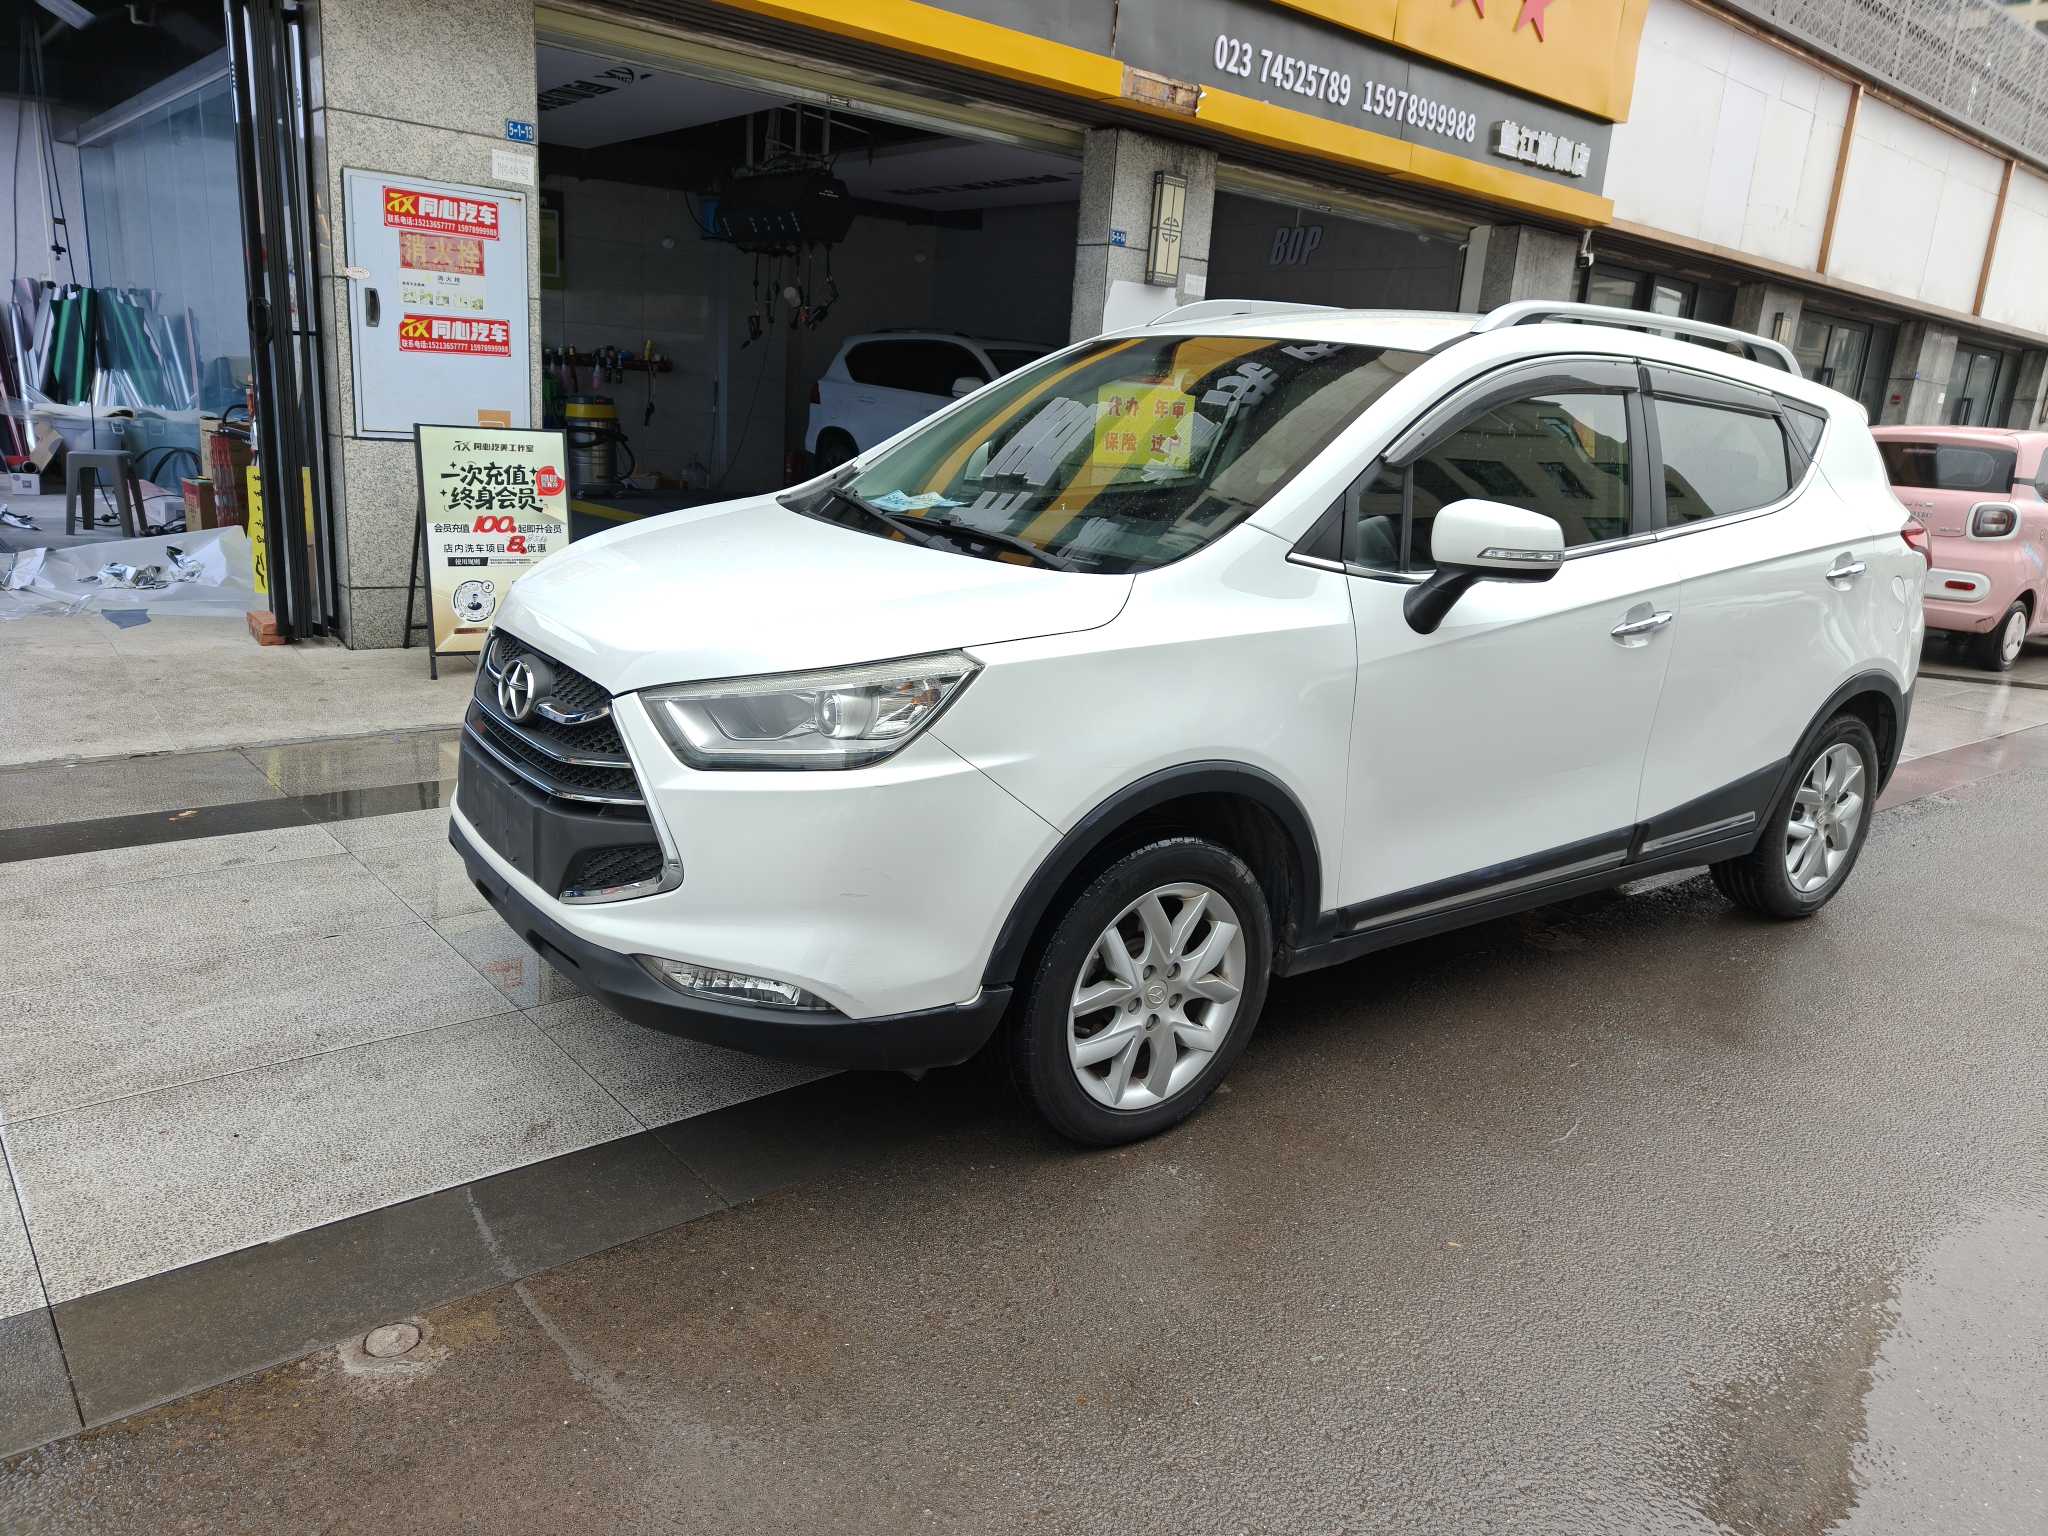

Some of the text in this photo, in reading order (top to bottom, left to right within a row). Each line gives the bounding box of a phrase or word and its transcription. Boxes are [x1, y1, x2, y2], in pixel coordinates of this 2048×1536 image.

[1214, 34, 1477, 143] 023 74525789 15978999988
[508, 122, 534, 138] 5-1-13
[418, 196, 497, 226] 同心汽车
[431, 320, 508, 343] 同心汽车
[1103, 431, 1137, 453] 保险
[448, 487, 543, 512] 终身会员
[434, 523, 469, 533] 会员充值
[518, 524, 562, 534] 起即升会员
[444, 543, 505, 553] 店内洗车项目
[528, 543, 546, 553] 优惠
